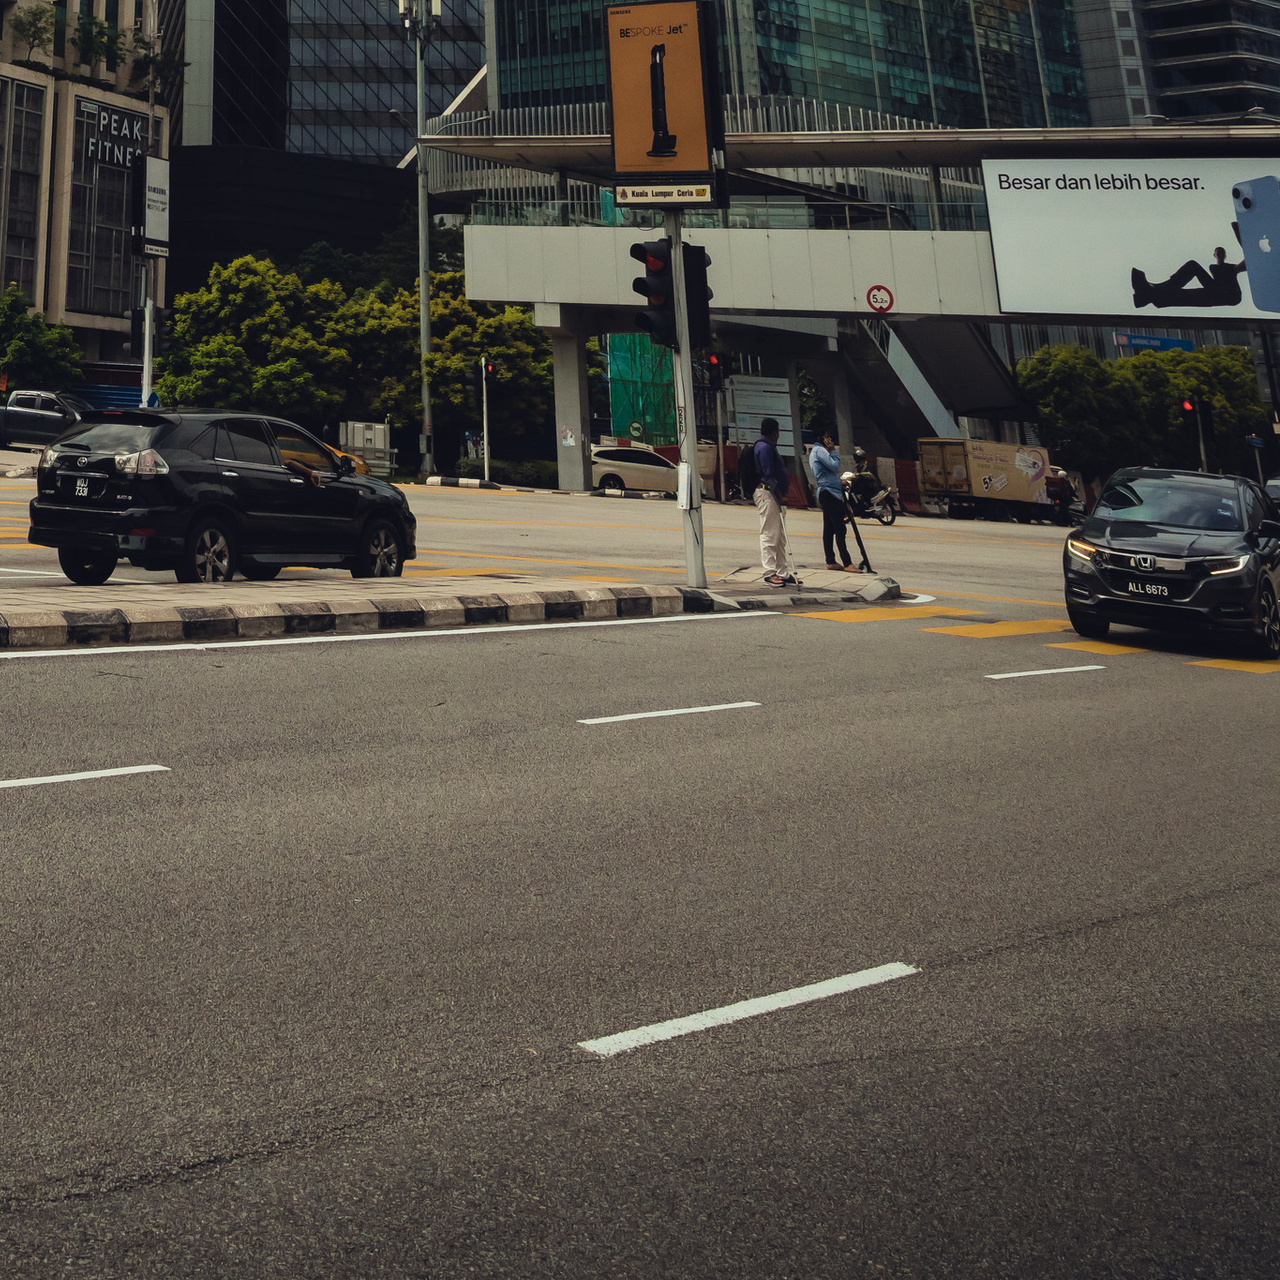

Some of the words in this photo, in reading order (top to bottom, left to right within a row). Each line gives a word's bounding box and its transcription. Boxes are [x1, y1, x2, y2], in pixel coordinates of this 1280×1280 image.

[619, 25, 664, 38] BESPOKE
[100, 111, 143, 142] PEAK
[998, 173, 1051, 190] Besar
[1055, 173, 1090, 190] dan
[1094, 173, 1142, 190] lebih
[1145, 173, 1205, 190] besar.
[631, 189, 649, 198] Kuala
[651, 189, 674, 198] Lumpur
[1128, 582, 1145, 594] ALL
[1145, 584, 1169, 597] 6673
